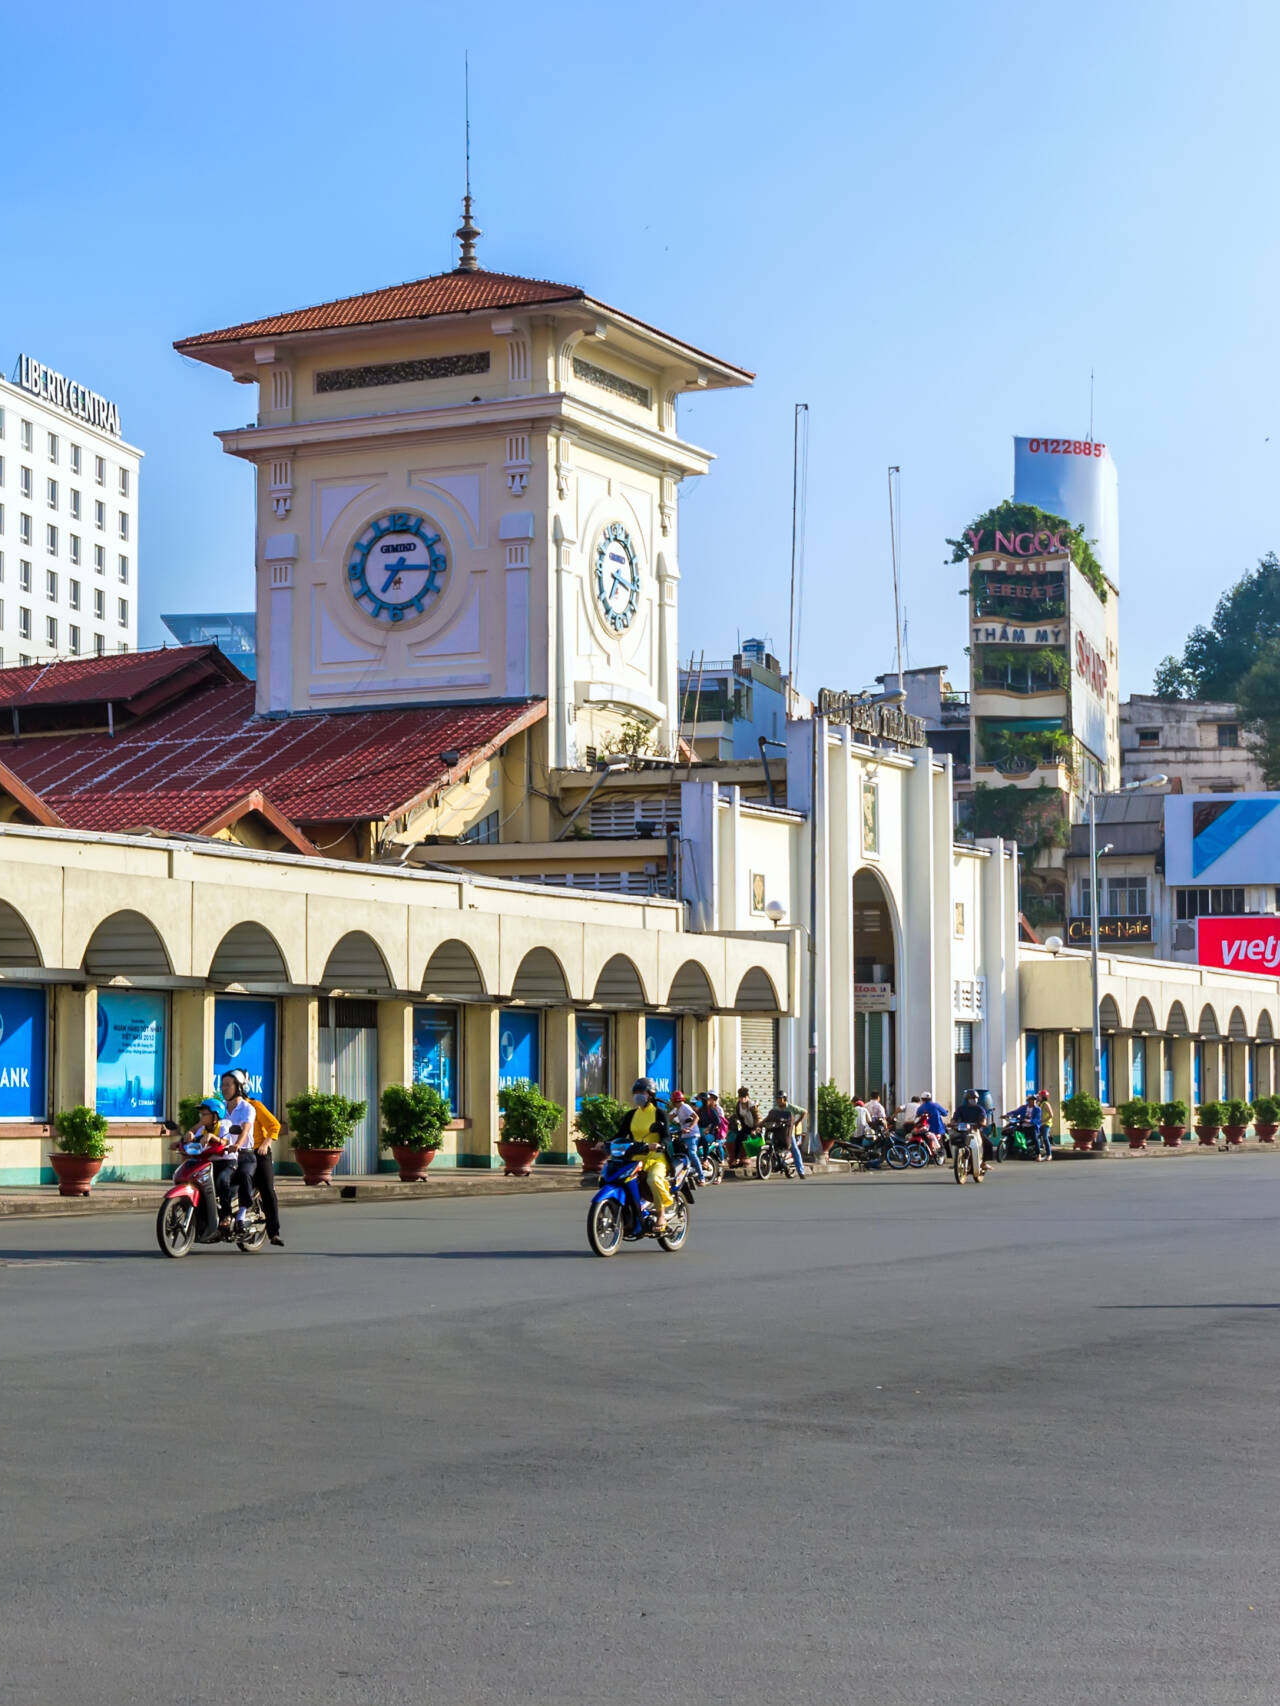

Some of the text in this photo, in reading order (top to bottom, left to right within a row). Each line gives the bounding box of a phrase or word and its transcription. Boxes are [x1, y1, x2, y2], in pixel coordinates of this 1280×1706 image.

[21, 354, 122, 436] LIBERTY CENTRAL
[1069, 920, 1149, 939] Clasic Nails
